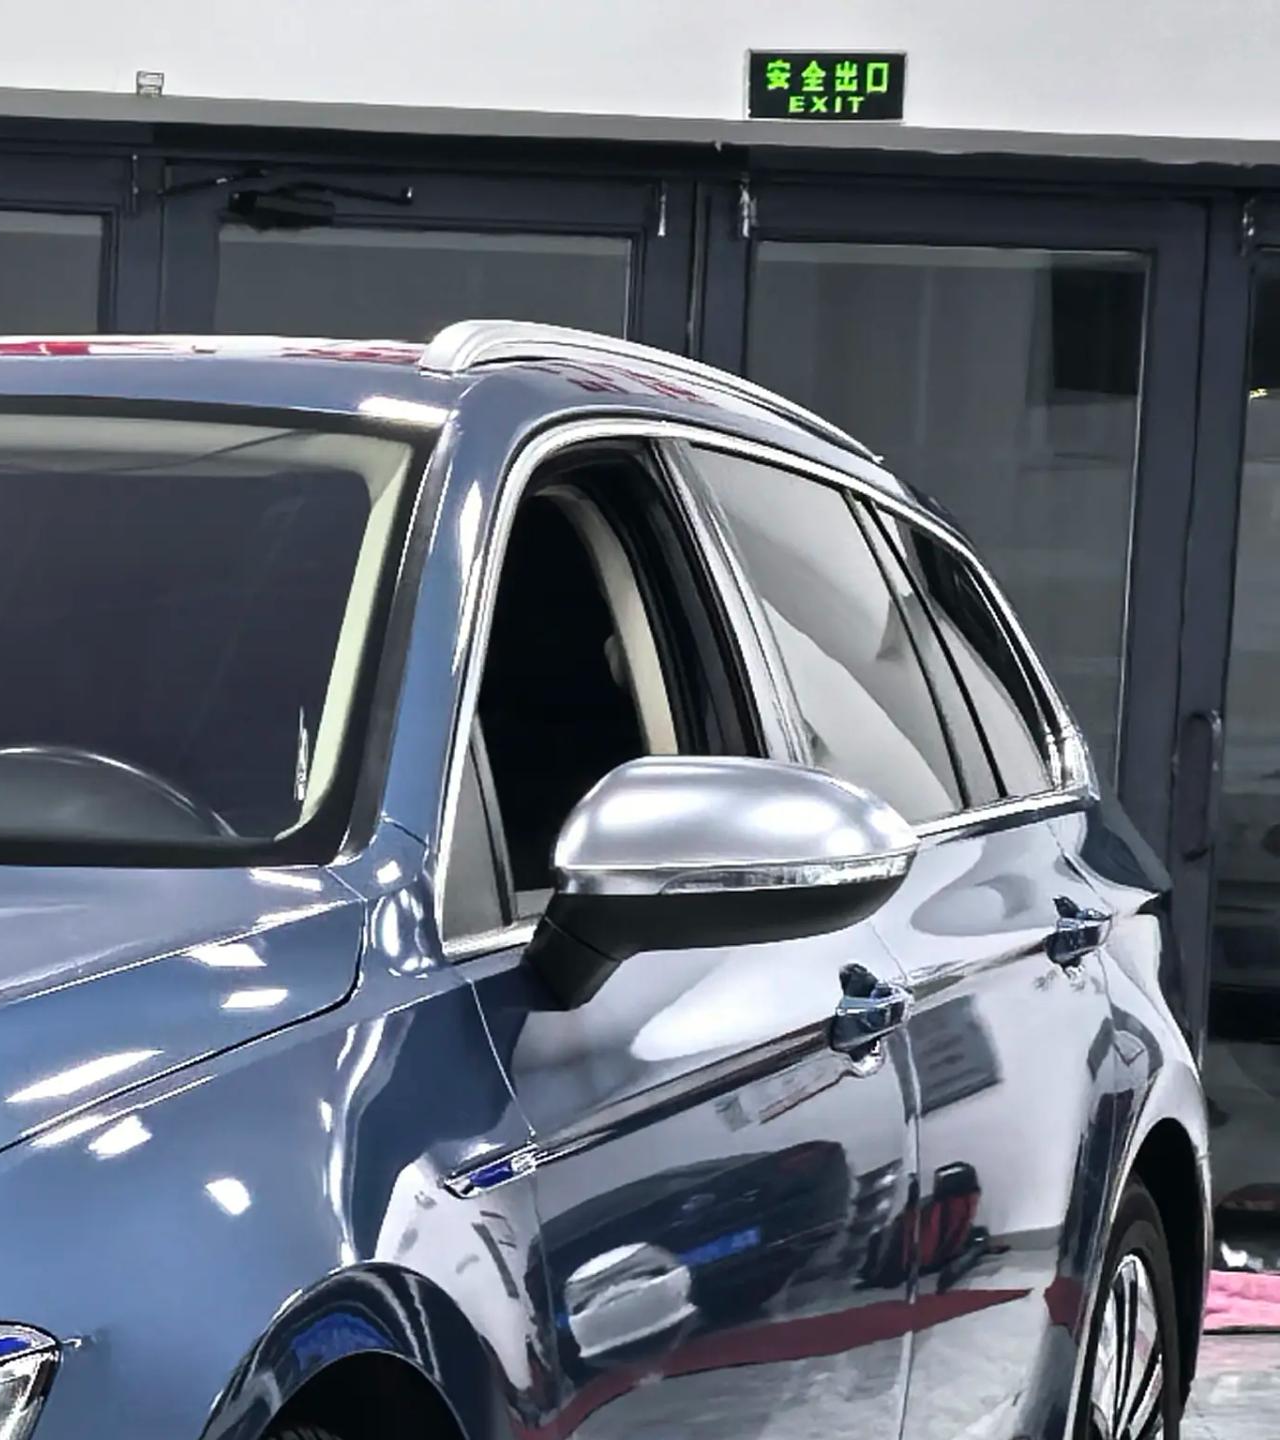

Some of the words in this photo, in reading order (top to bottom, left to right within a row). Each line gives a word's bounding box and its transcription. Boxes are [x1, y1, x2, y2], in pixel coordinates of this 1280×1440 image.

[766, 59, 889, 93] 安全出口
[789, 96, 865, 113] EXIT
